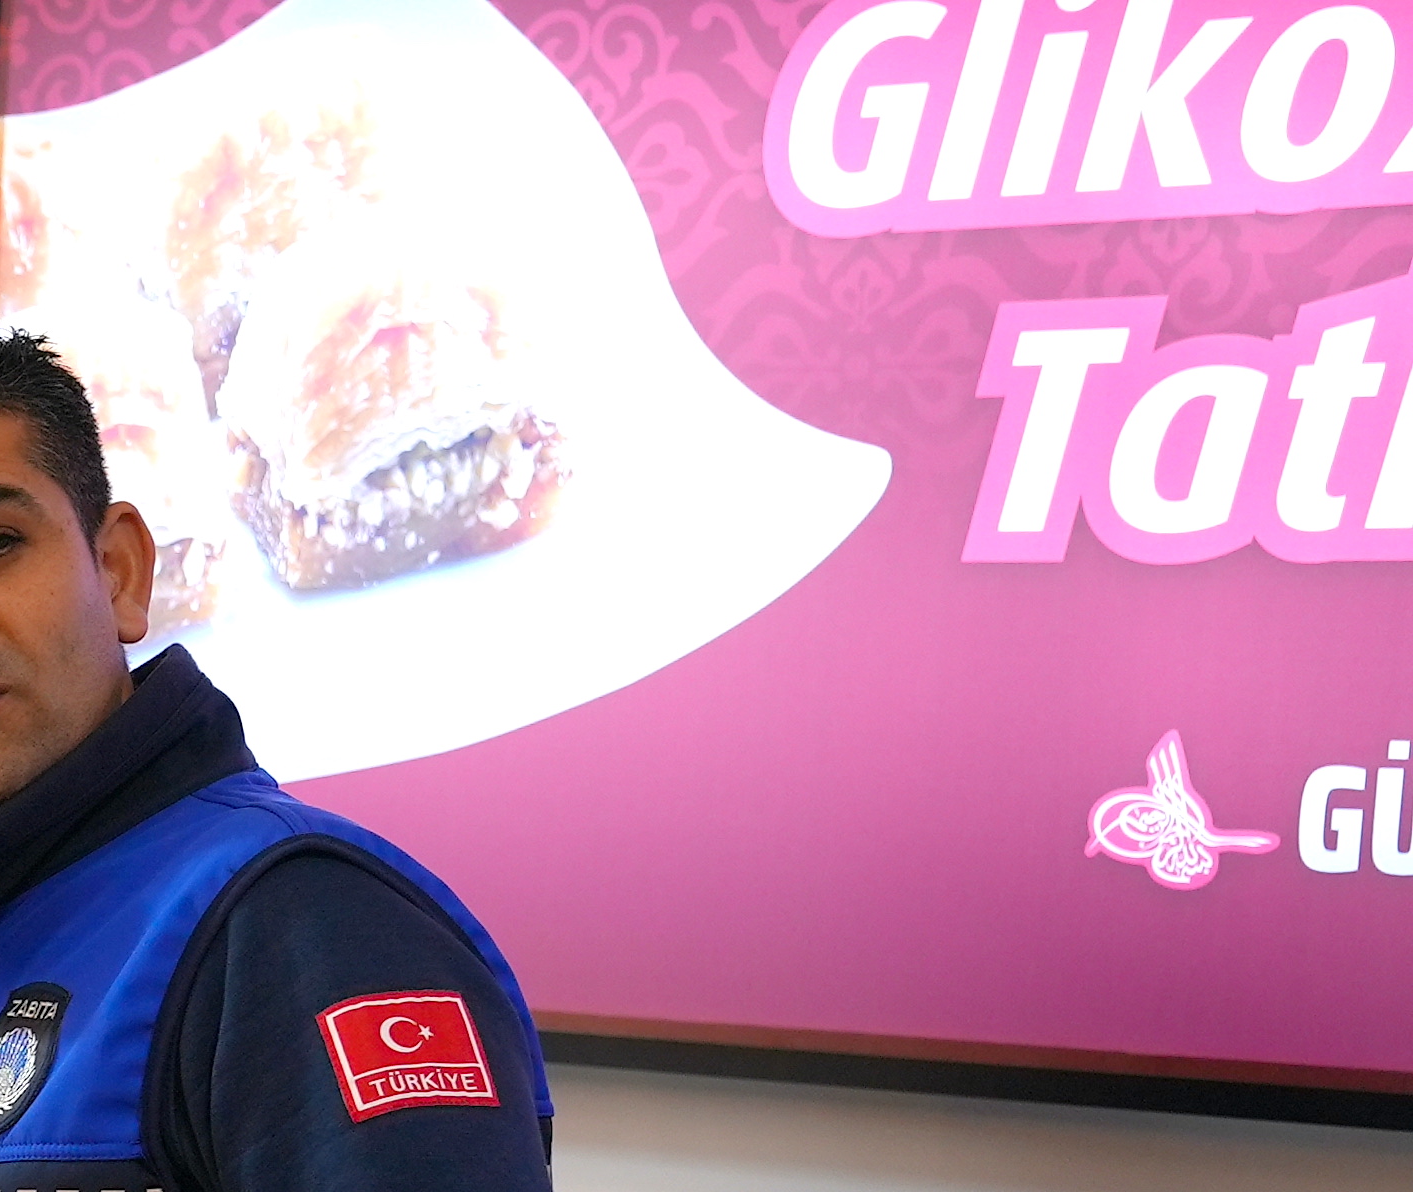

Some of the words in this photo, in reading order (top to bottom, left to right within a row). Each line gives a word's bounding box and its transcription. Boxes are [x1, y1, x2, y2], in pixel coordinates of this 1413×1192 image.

[788, 0, 1413, 209] Gliko
[6, 999, 59, 1020] ZABITA
[368, 1067, 478, 1097] TÜRKİYE
